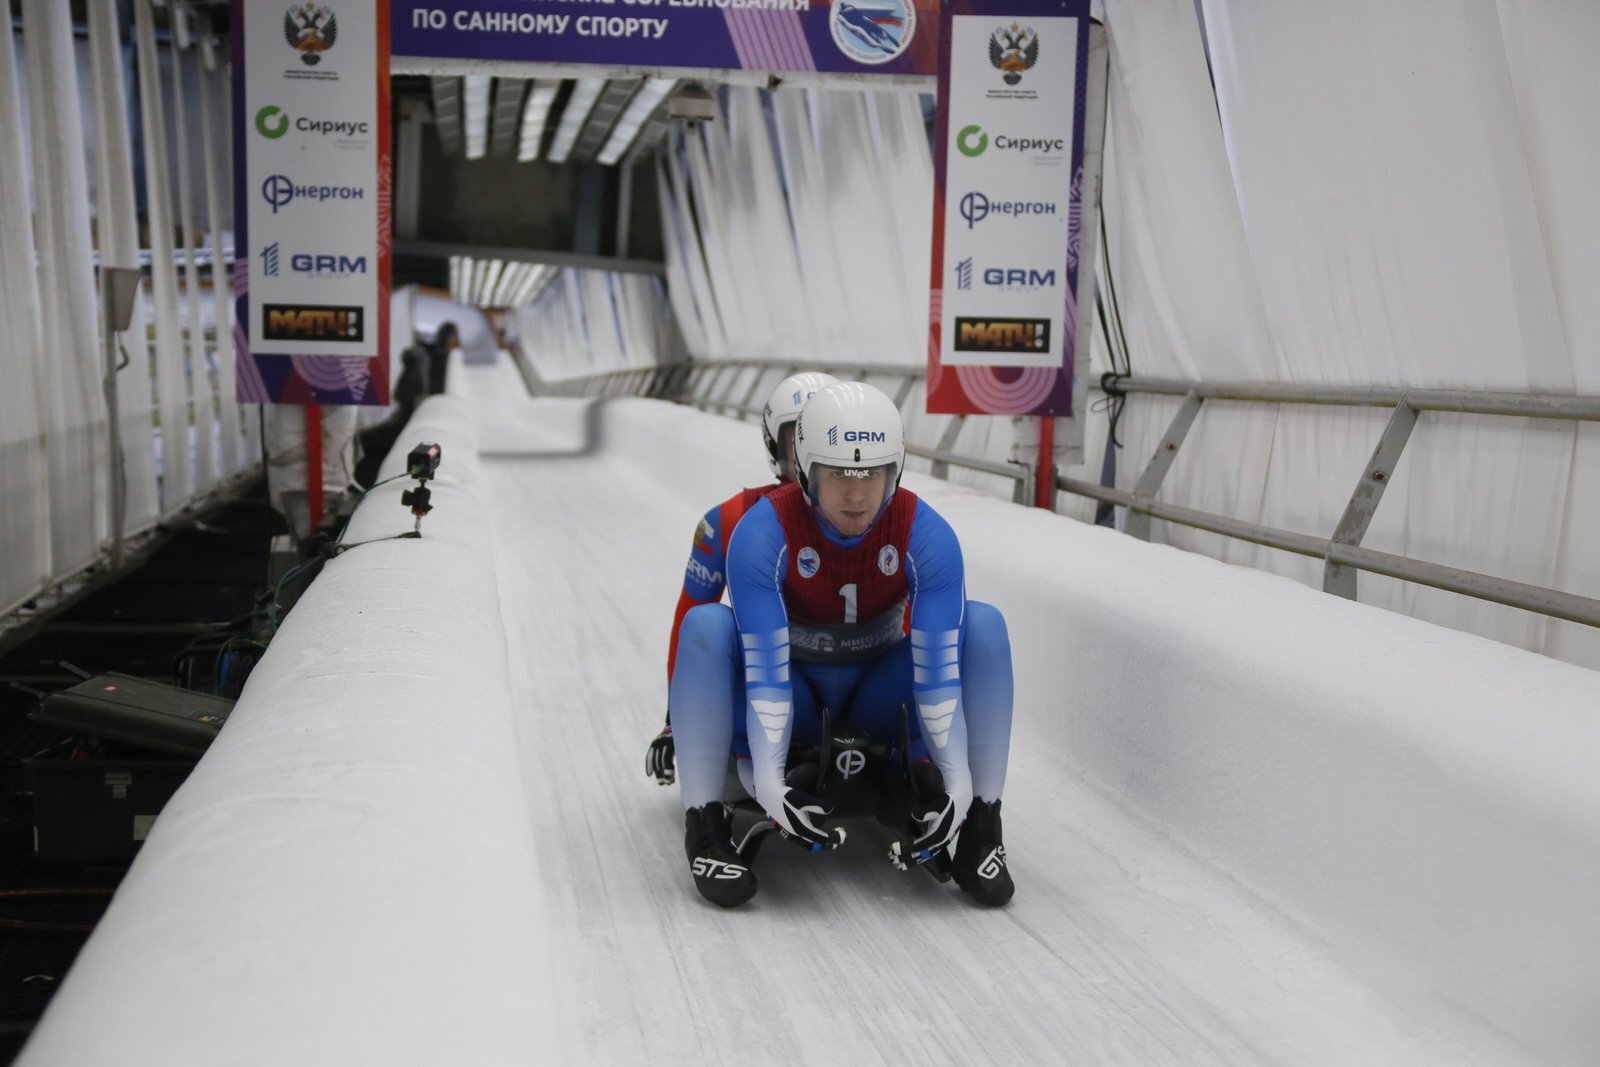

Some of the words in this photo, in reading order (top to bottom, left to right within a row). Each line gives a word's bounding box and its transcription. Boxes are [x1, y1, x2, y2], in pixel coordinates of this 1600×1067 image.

[412, 8, 447, 29] ПО
[453, 11, 570, 34] САННОМУ
[575, 16, 669, 38] СПОРТУ
[295, 116, 369, 136] Сириус
[994, 135, 1064, 153] Сириус
[291, 253, 367, 273] GRM
[983, 268, 1056, 287] GRM
[269, 309, 358, 337] МАТЧ!
[960, 322, 1045, 349] МАТЧ!
[843, 430, 886, 443] GRM
[843, 469, 870, 479] uvex
[838, 583, 858, 624] 1
